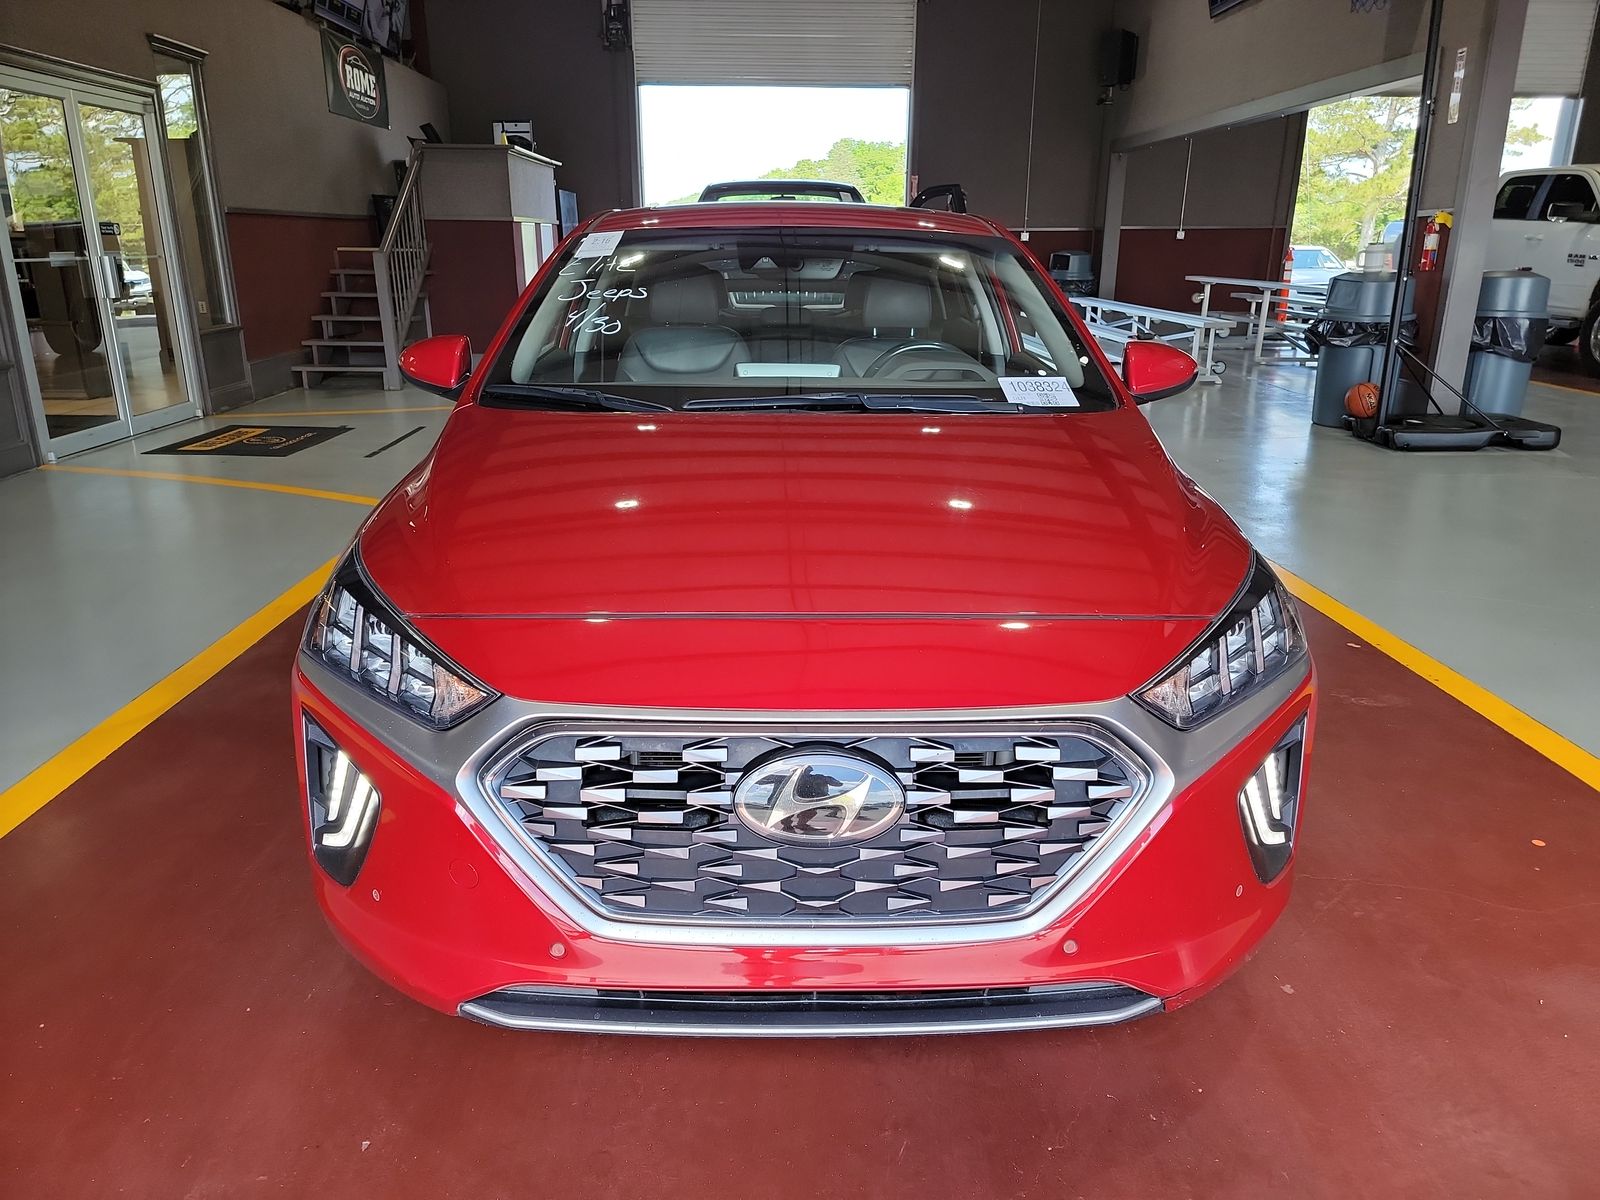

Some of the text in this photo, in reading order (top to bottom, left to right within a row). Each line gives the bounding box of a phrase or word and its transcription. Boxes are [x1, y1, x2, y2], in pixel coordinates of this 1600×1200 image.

[344, 63, 376, 98] ROME
[557, 278, 648, 302] Jeeps
[565, 302, 621, 334] 4/30
[1009, 381, 1071, 393] 1038324
